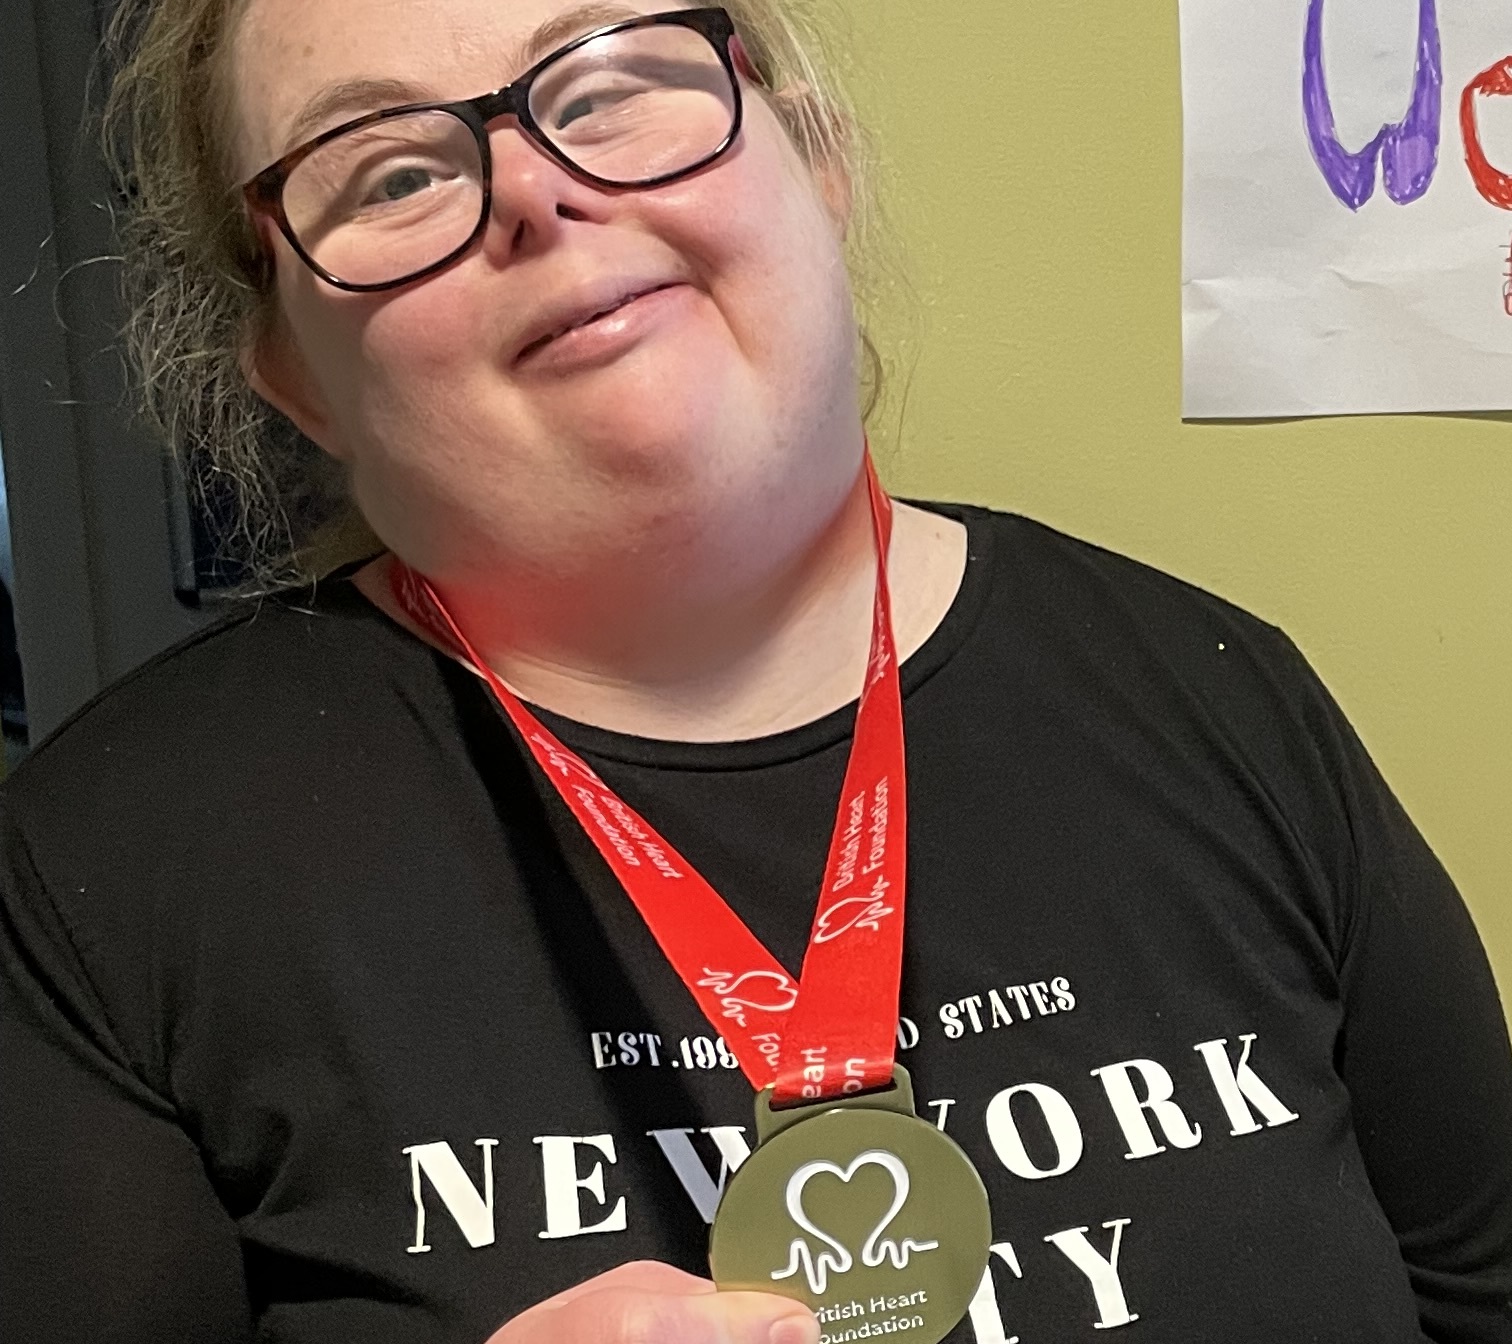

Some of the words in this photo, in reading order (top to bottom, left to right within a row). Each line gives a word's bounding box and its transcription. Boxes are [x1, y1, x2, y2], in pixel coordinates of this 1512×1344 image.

[861, 775, 889, 875] Foundation
[938, 976, 1077, 1040] STATES
[800, 1045, 829, 1099] eart
[928, 1031, 1300, 1181] ORK
[870, 1290, 928, 1314] Heart
